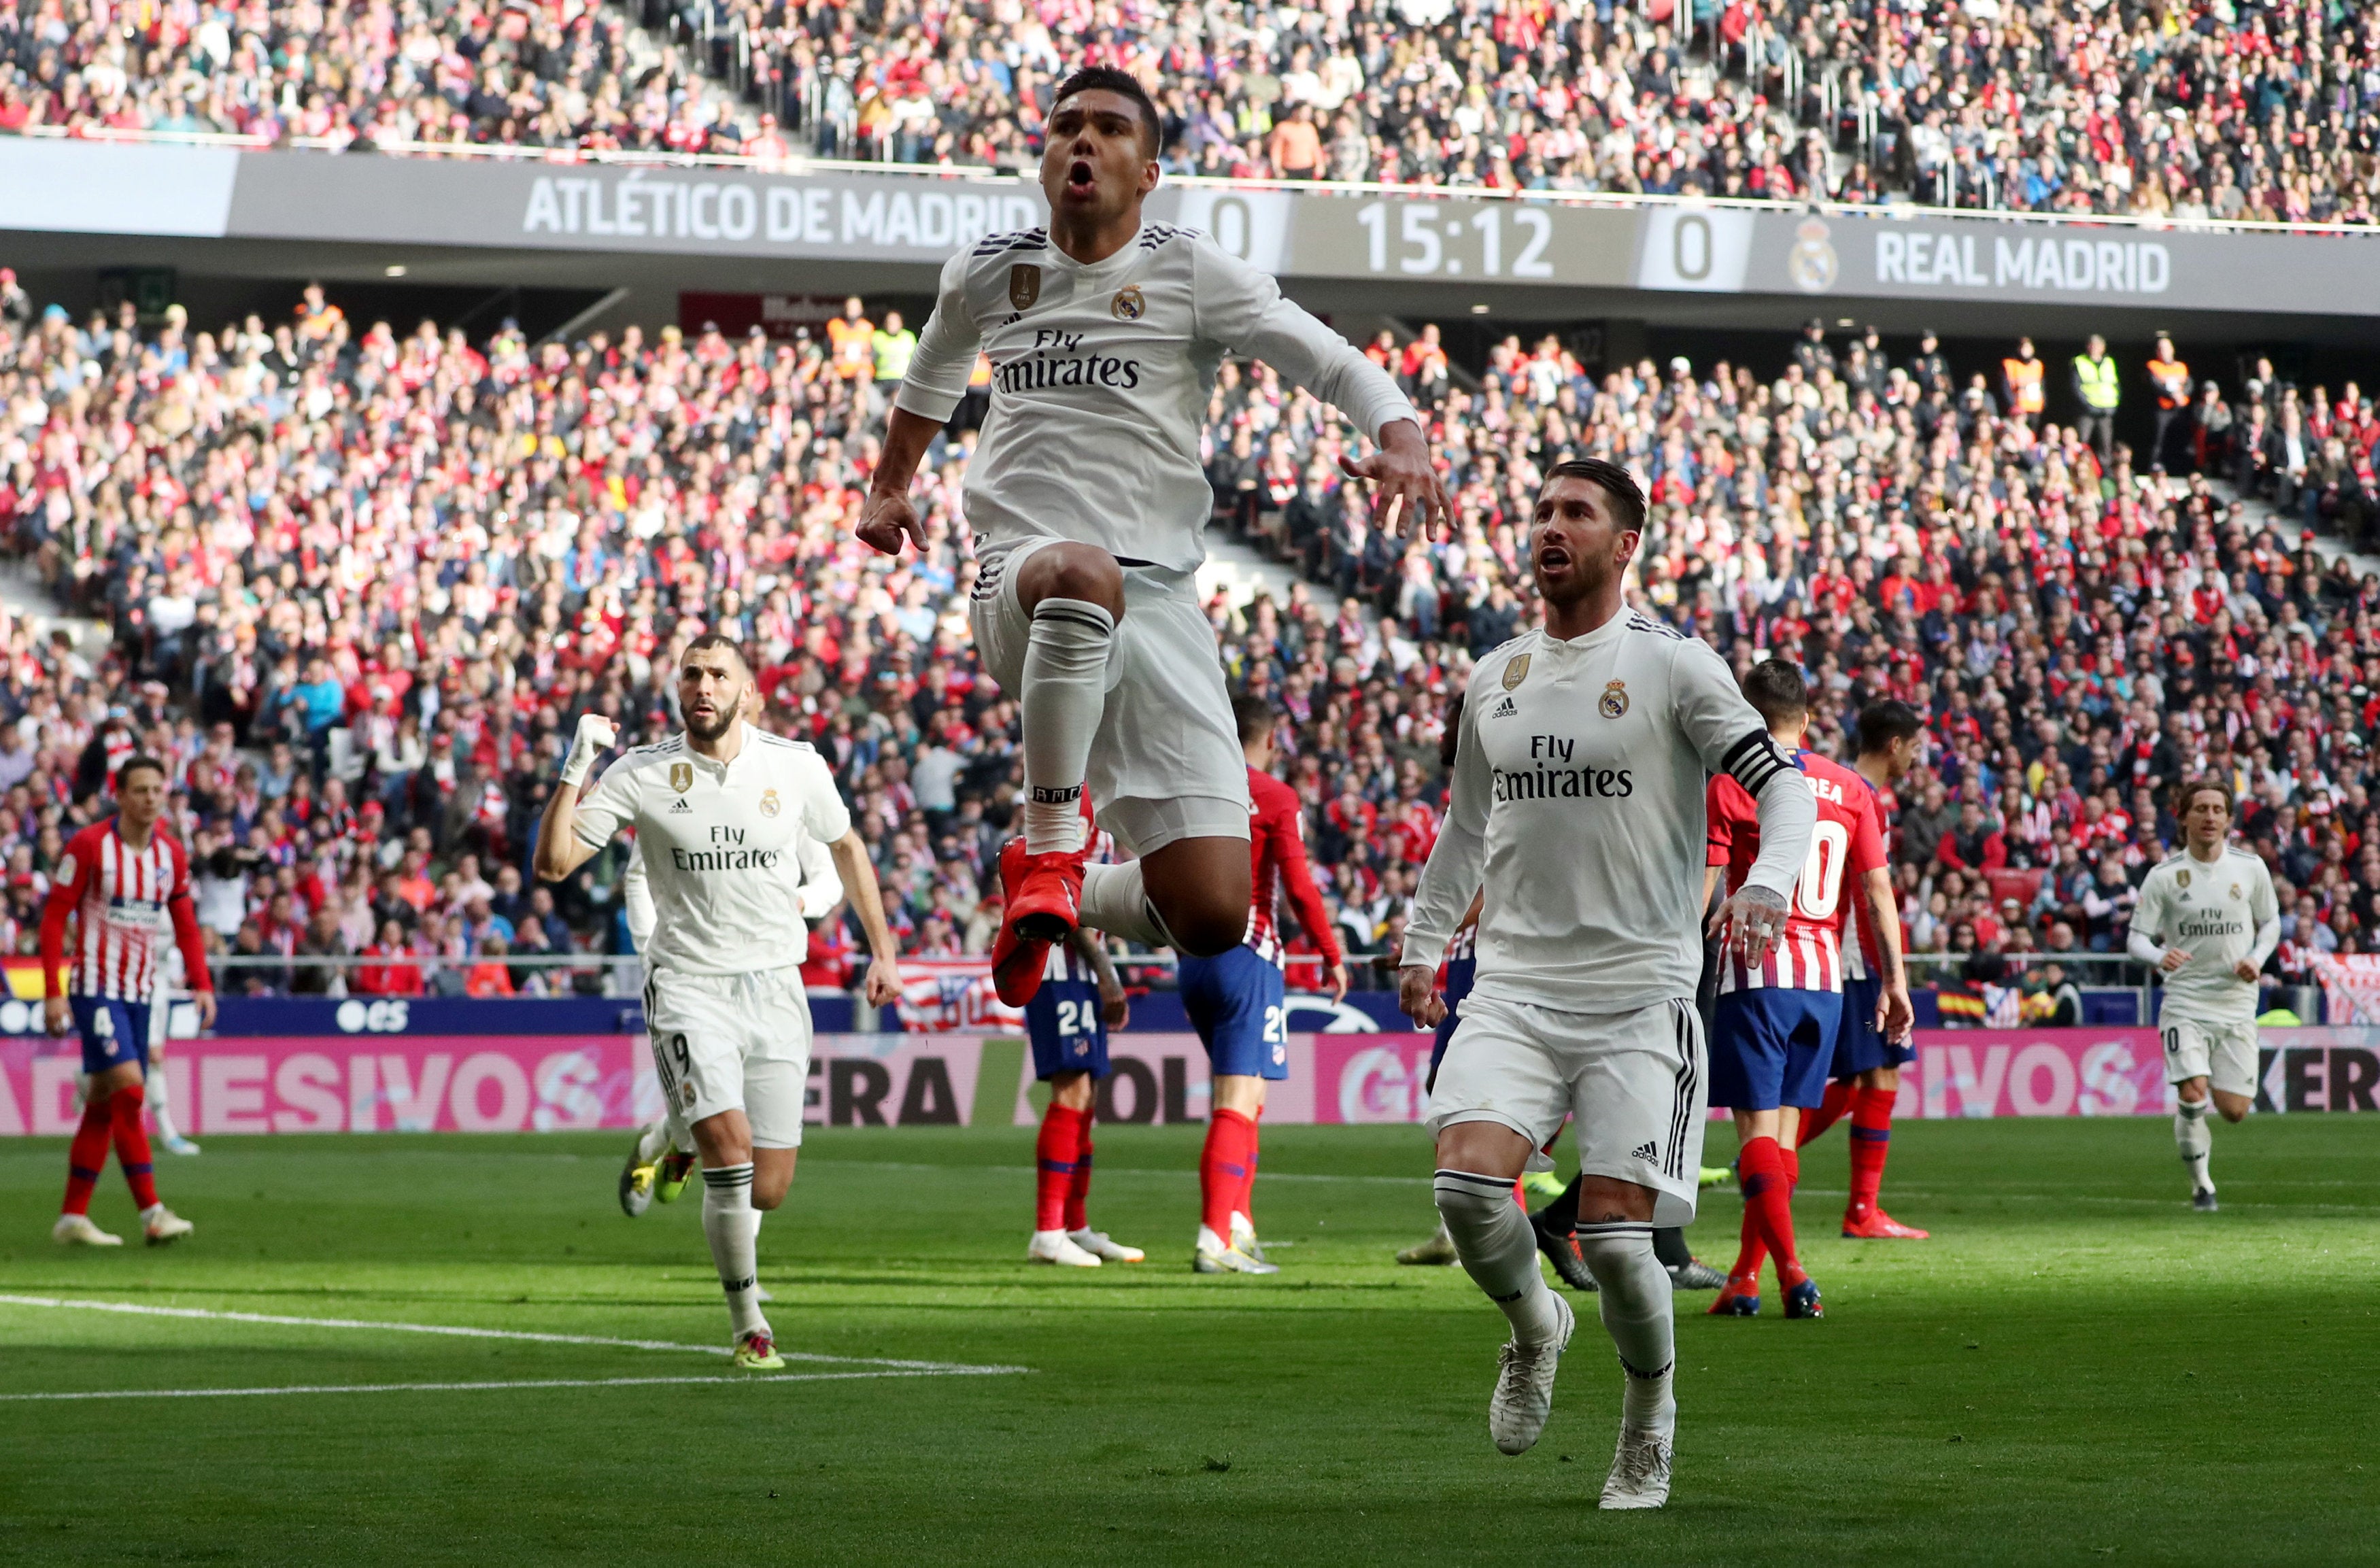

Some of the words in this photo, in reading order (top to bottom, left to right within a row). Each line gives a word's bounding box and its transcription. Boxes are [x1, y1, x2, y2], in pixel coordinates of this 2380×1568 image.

[524, 169, 753, 241] ATLÉTICO
[766, 186, 832, 243] DE
[841, 189, 1038, 248] MADRID
[1211, 197, 1251, 261] 0
[1359, 201, 1554, 277] 15:12
[1673, 212, 1712, 280] 0
[1875, 232, 1989, 287] REAL
[1995, 237, 2170, 293] MADRID
[1034, 330, 1084, 352] Fly
[1492, 709, 1518, 719] adidas
[1531, 735, 1574, 763] Fly
[1493, 762, 1633, 802] Emirates
[1805, 777, 1843, 806] REA
[711, 825, 745, 845] Fly
[670, 845, 780, 872] Emirates
[2178, 920, 2243, 937] Emirates
[92, 1006, 115, 1038] 4
[1056, 999, 1098, 1037] 24
[671, 1033, 690, 1078] 9
[1632, 1151, 1659, 1167] adidas
